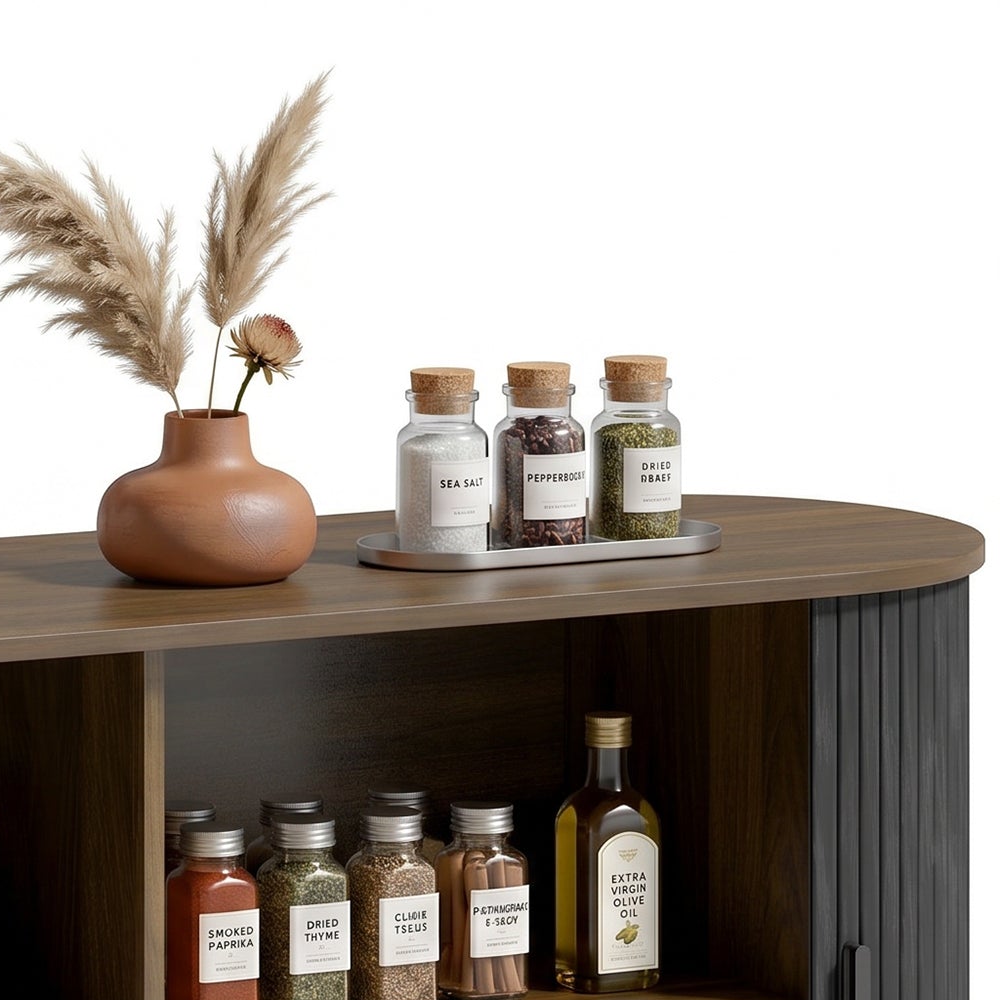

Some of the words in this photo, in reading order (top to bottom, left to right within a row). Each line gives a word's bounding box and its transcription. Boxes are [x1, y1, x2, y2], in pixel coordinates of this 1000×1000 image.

[641, 461, 671, 471] DRIED
[440, 479, 461, 489] SEA
[463, 477, 484, 488] SALT
[611, 871, 647, 884] EXTRA
[610, 883, 647, 896] VIRGIN
[613, 895, 645, 908] OLIVE
[619, 908, 638, 919] OIL
[306, 918, 339, 930] DRIED
[208, 926, 254, 939] SMOKED
[304, 930, 340, 942] THYME
[208, 938, 254, 951] PAPRIKA
